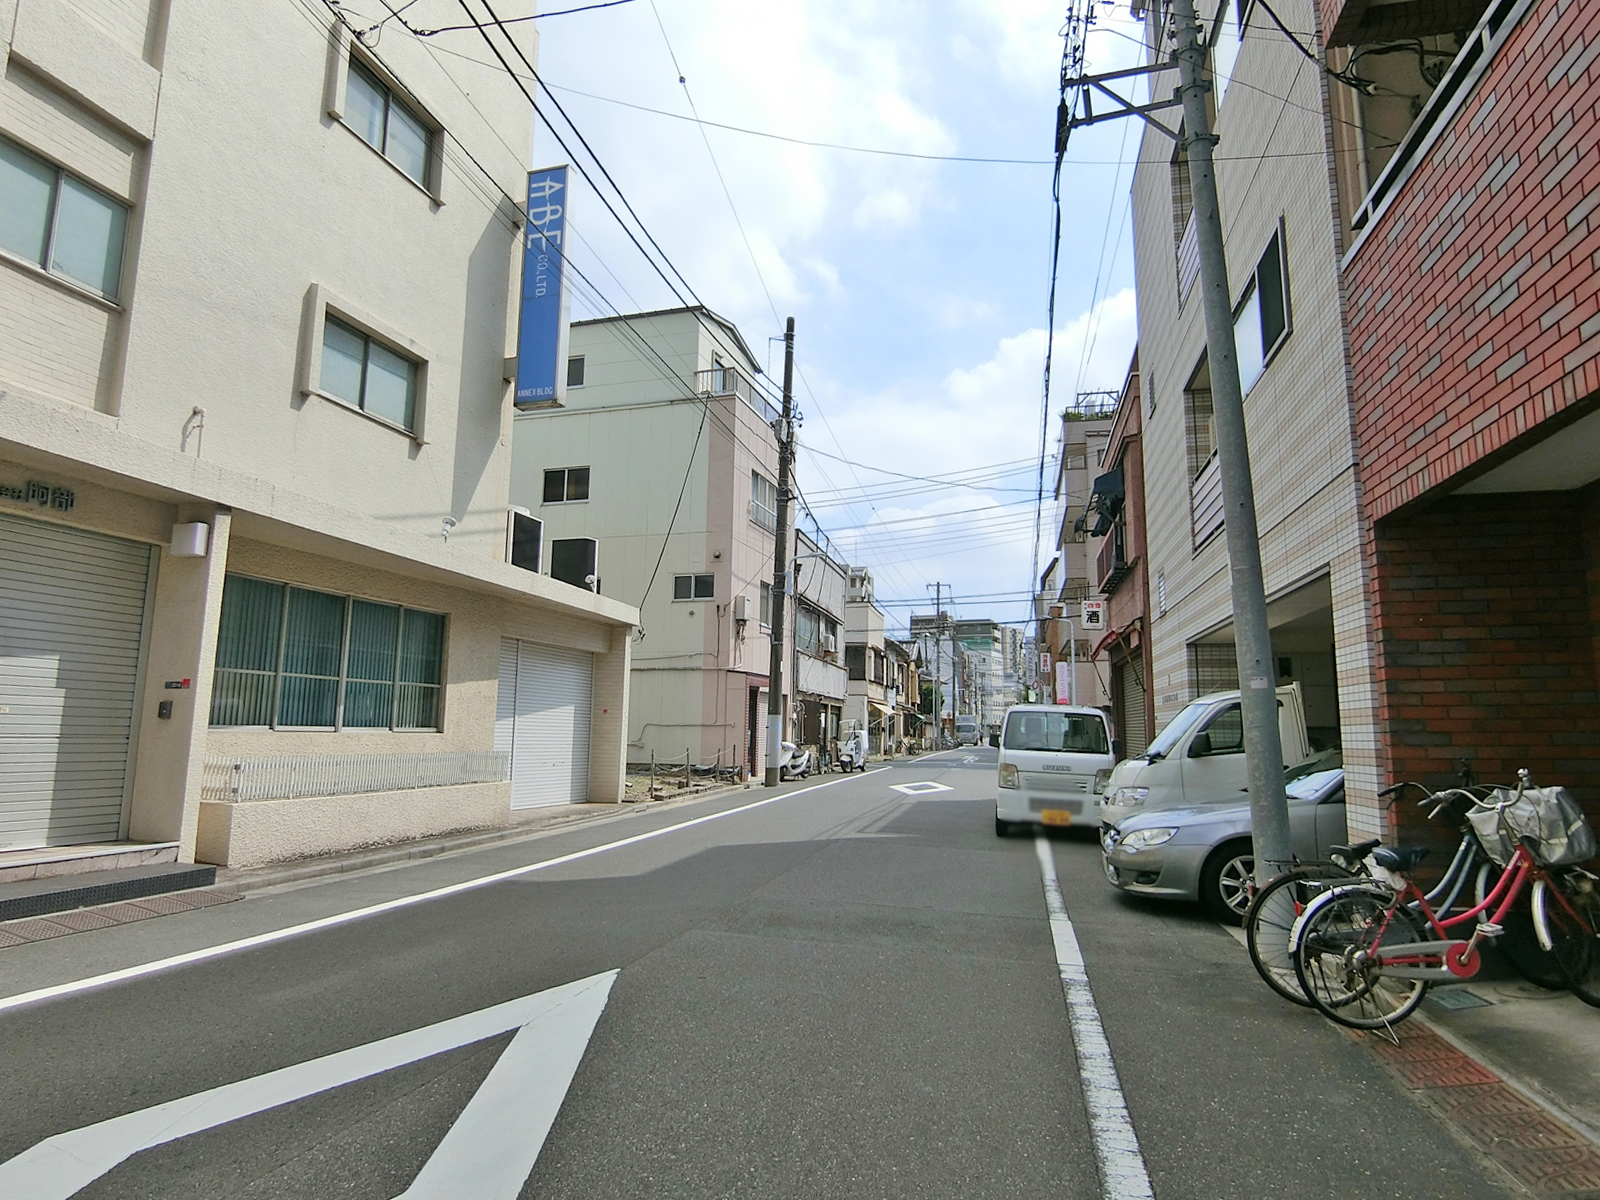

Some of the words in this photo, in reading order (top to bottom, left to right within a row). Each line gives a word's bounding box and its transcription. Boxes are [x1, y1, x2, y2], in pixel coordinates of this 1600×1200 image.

[527, 176, 565, 252] ABE
[517, 388, 536, 397] ANNEX
[1086, 610, 1100, 624] 酒
